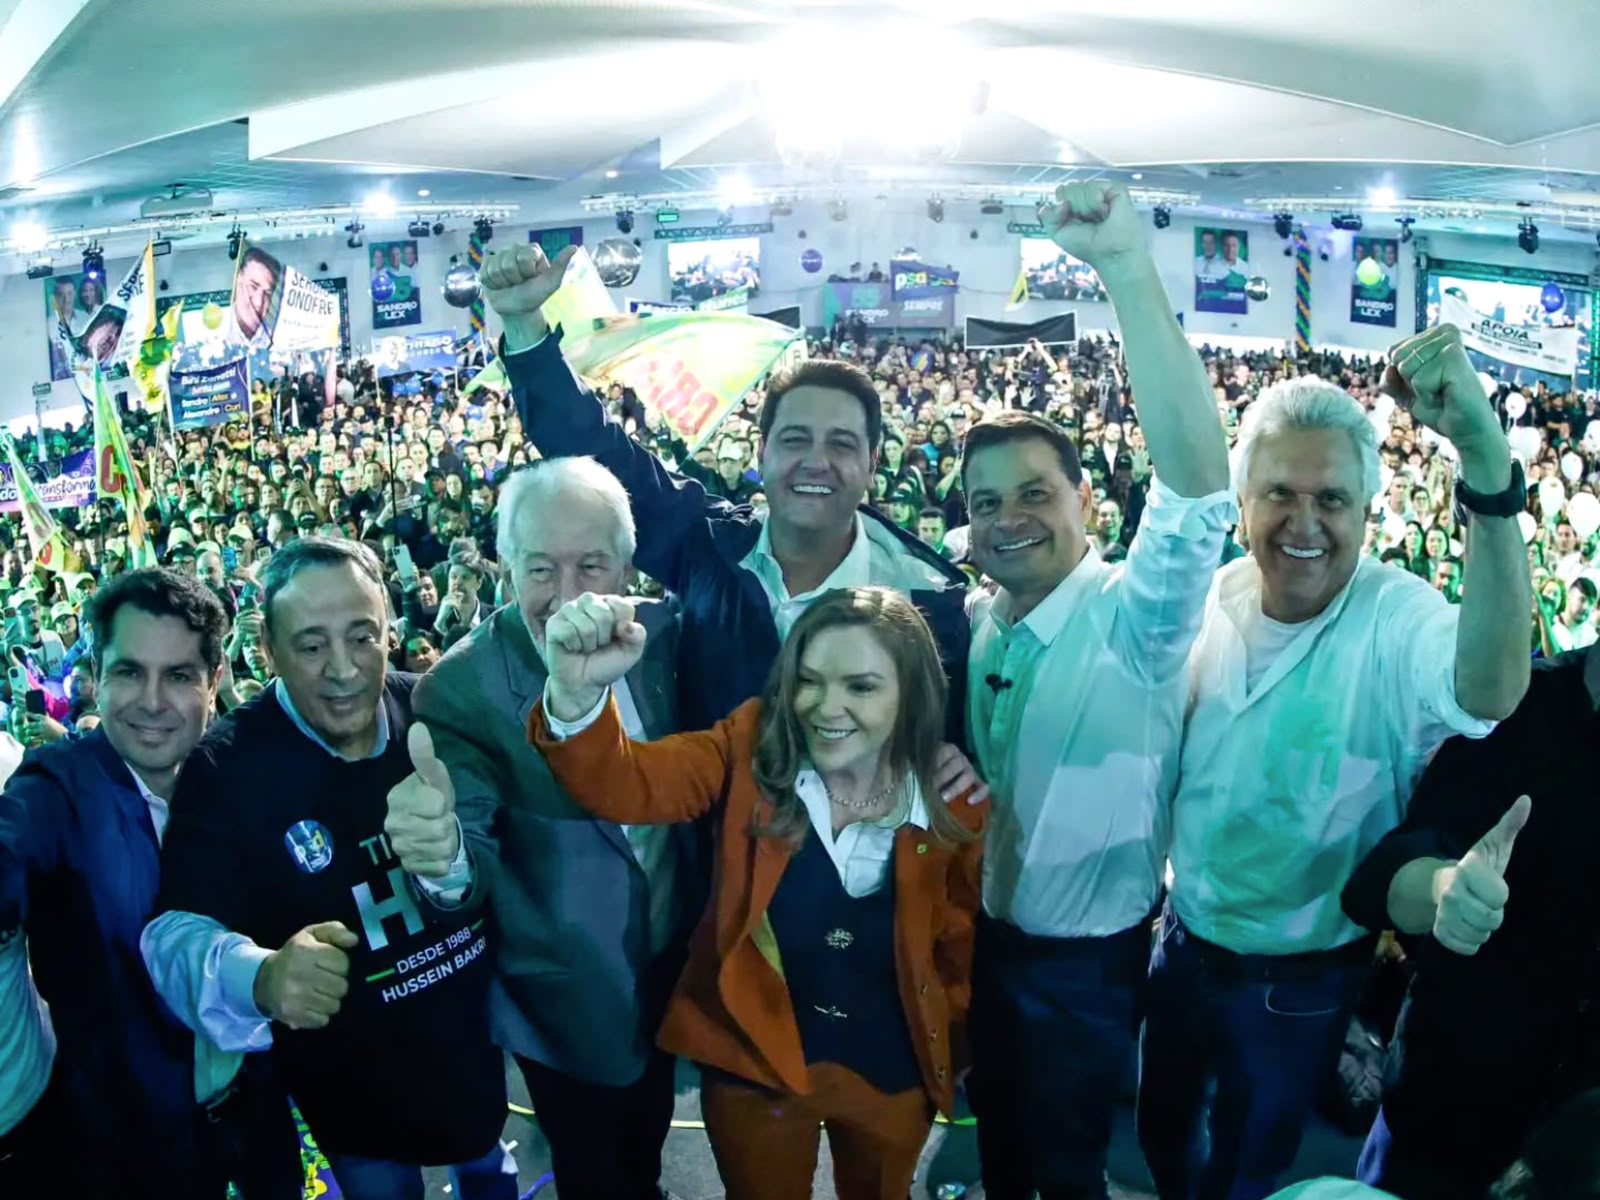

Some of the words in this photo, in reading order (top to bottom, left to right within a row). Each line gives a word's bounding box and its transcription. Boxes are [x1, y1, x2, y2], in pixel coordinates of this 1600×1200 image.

[286, 288, 334, 315] ONOFRE
[1481, 319, 1529, 340] APOIA
[358, 833, 392, 866] TI
[351, 866, 425, 951] H
[396, 942, 446, 974] DESDE
[445, 926, 472, 950] 1988
[382, 960, 453, 1003] HUSSEIN
